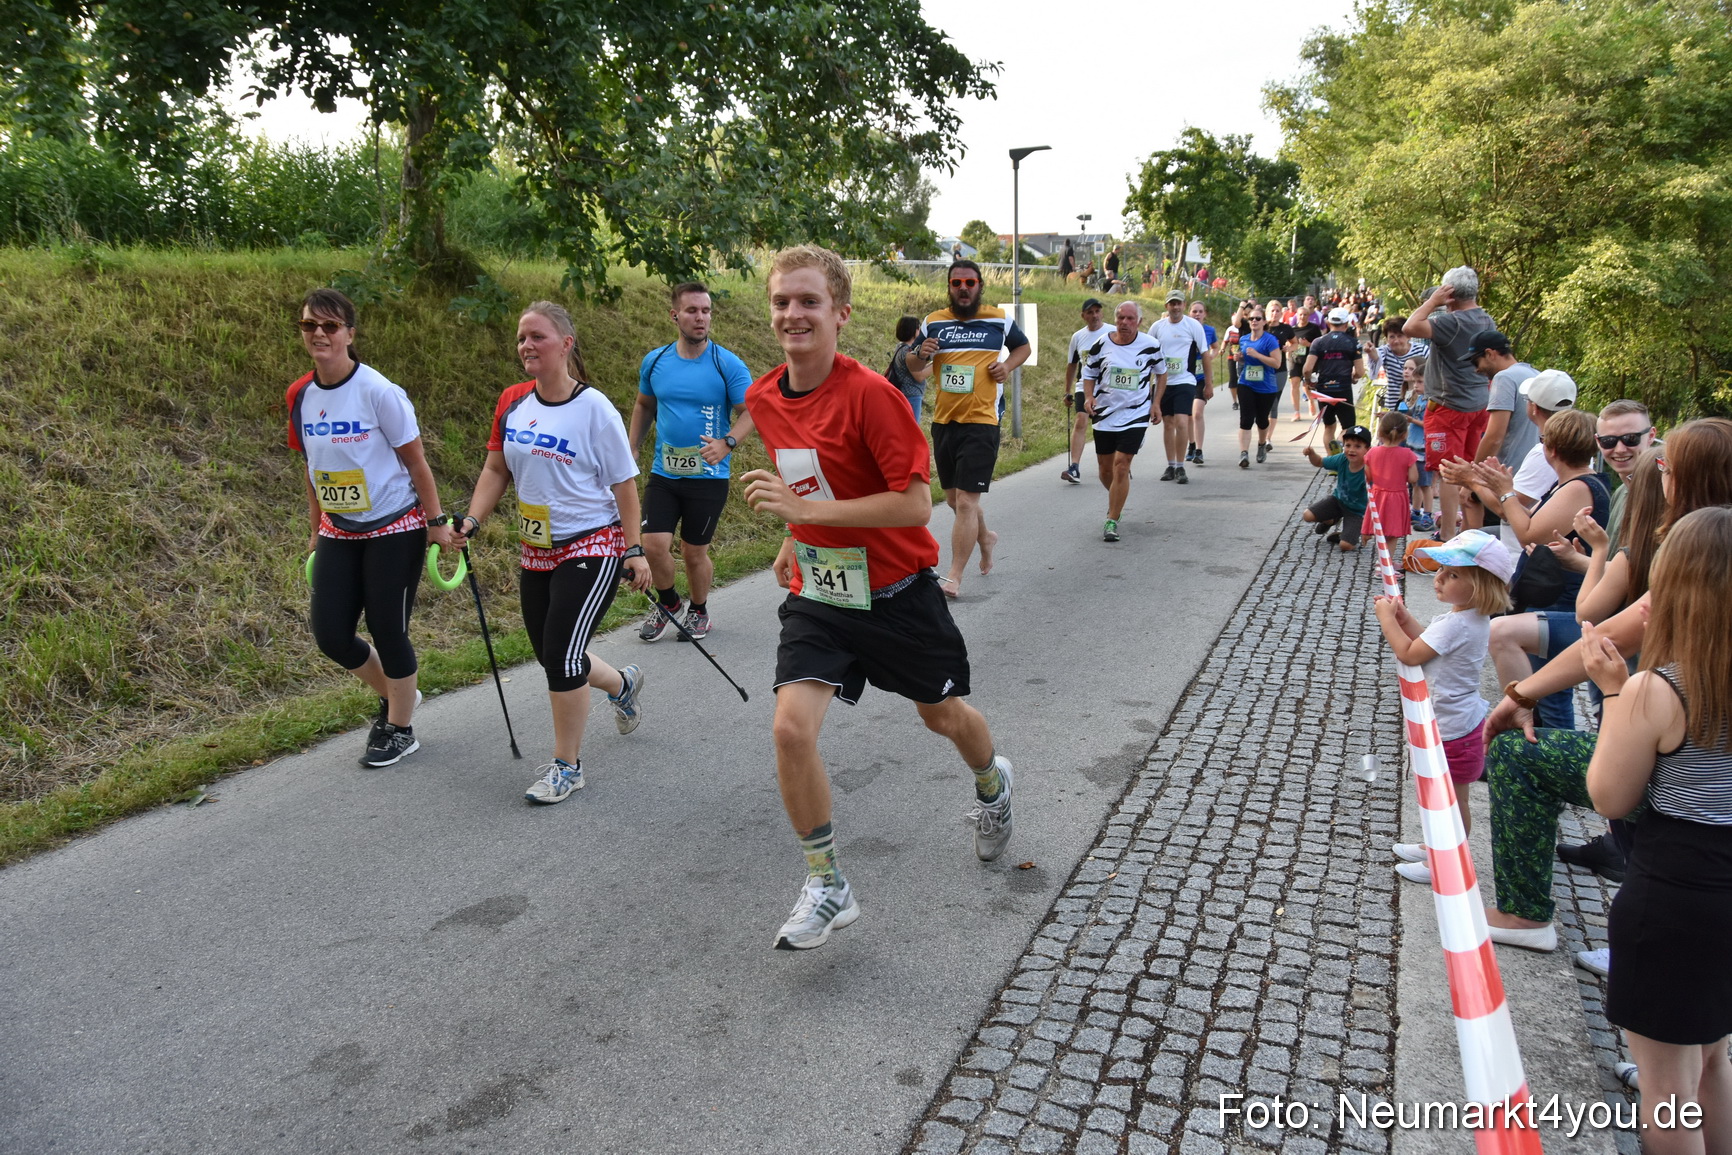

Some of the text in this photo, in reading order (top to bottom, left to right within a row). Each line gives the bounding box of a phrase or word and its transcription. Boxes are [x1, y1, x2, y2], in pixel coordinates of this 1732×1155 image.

[945, 327, 988, 339] Fischer
[945, 374, 965, 386] 763
[1115, 374, 1132, 385] 801
[331, 432, 369, 444] energie
[531, 447, 573, 466] energie
[666, 455, 697, 468] 1726
[320, 485, 361, 502] 2073
[811, 565, 848, 592] 541
